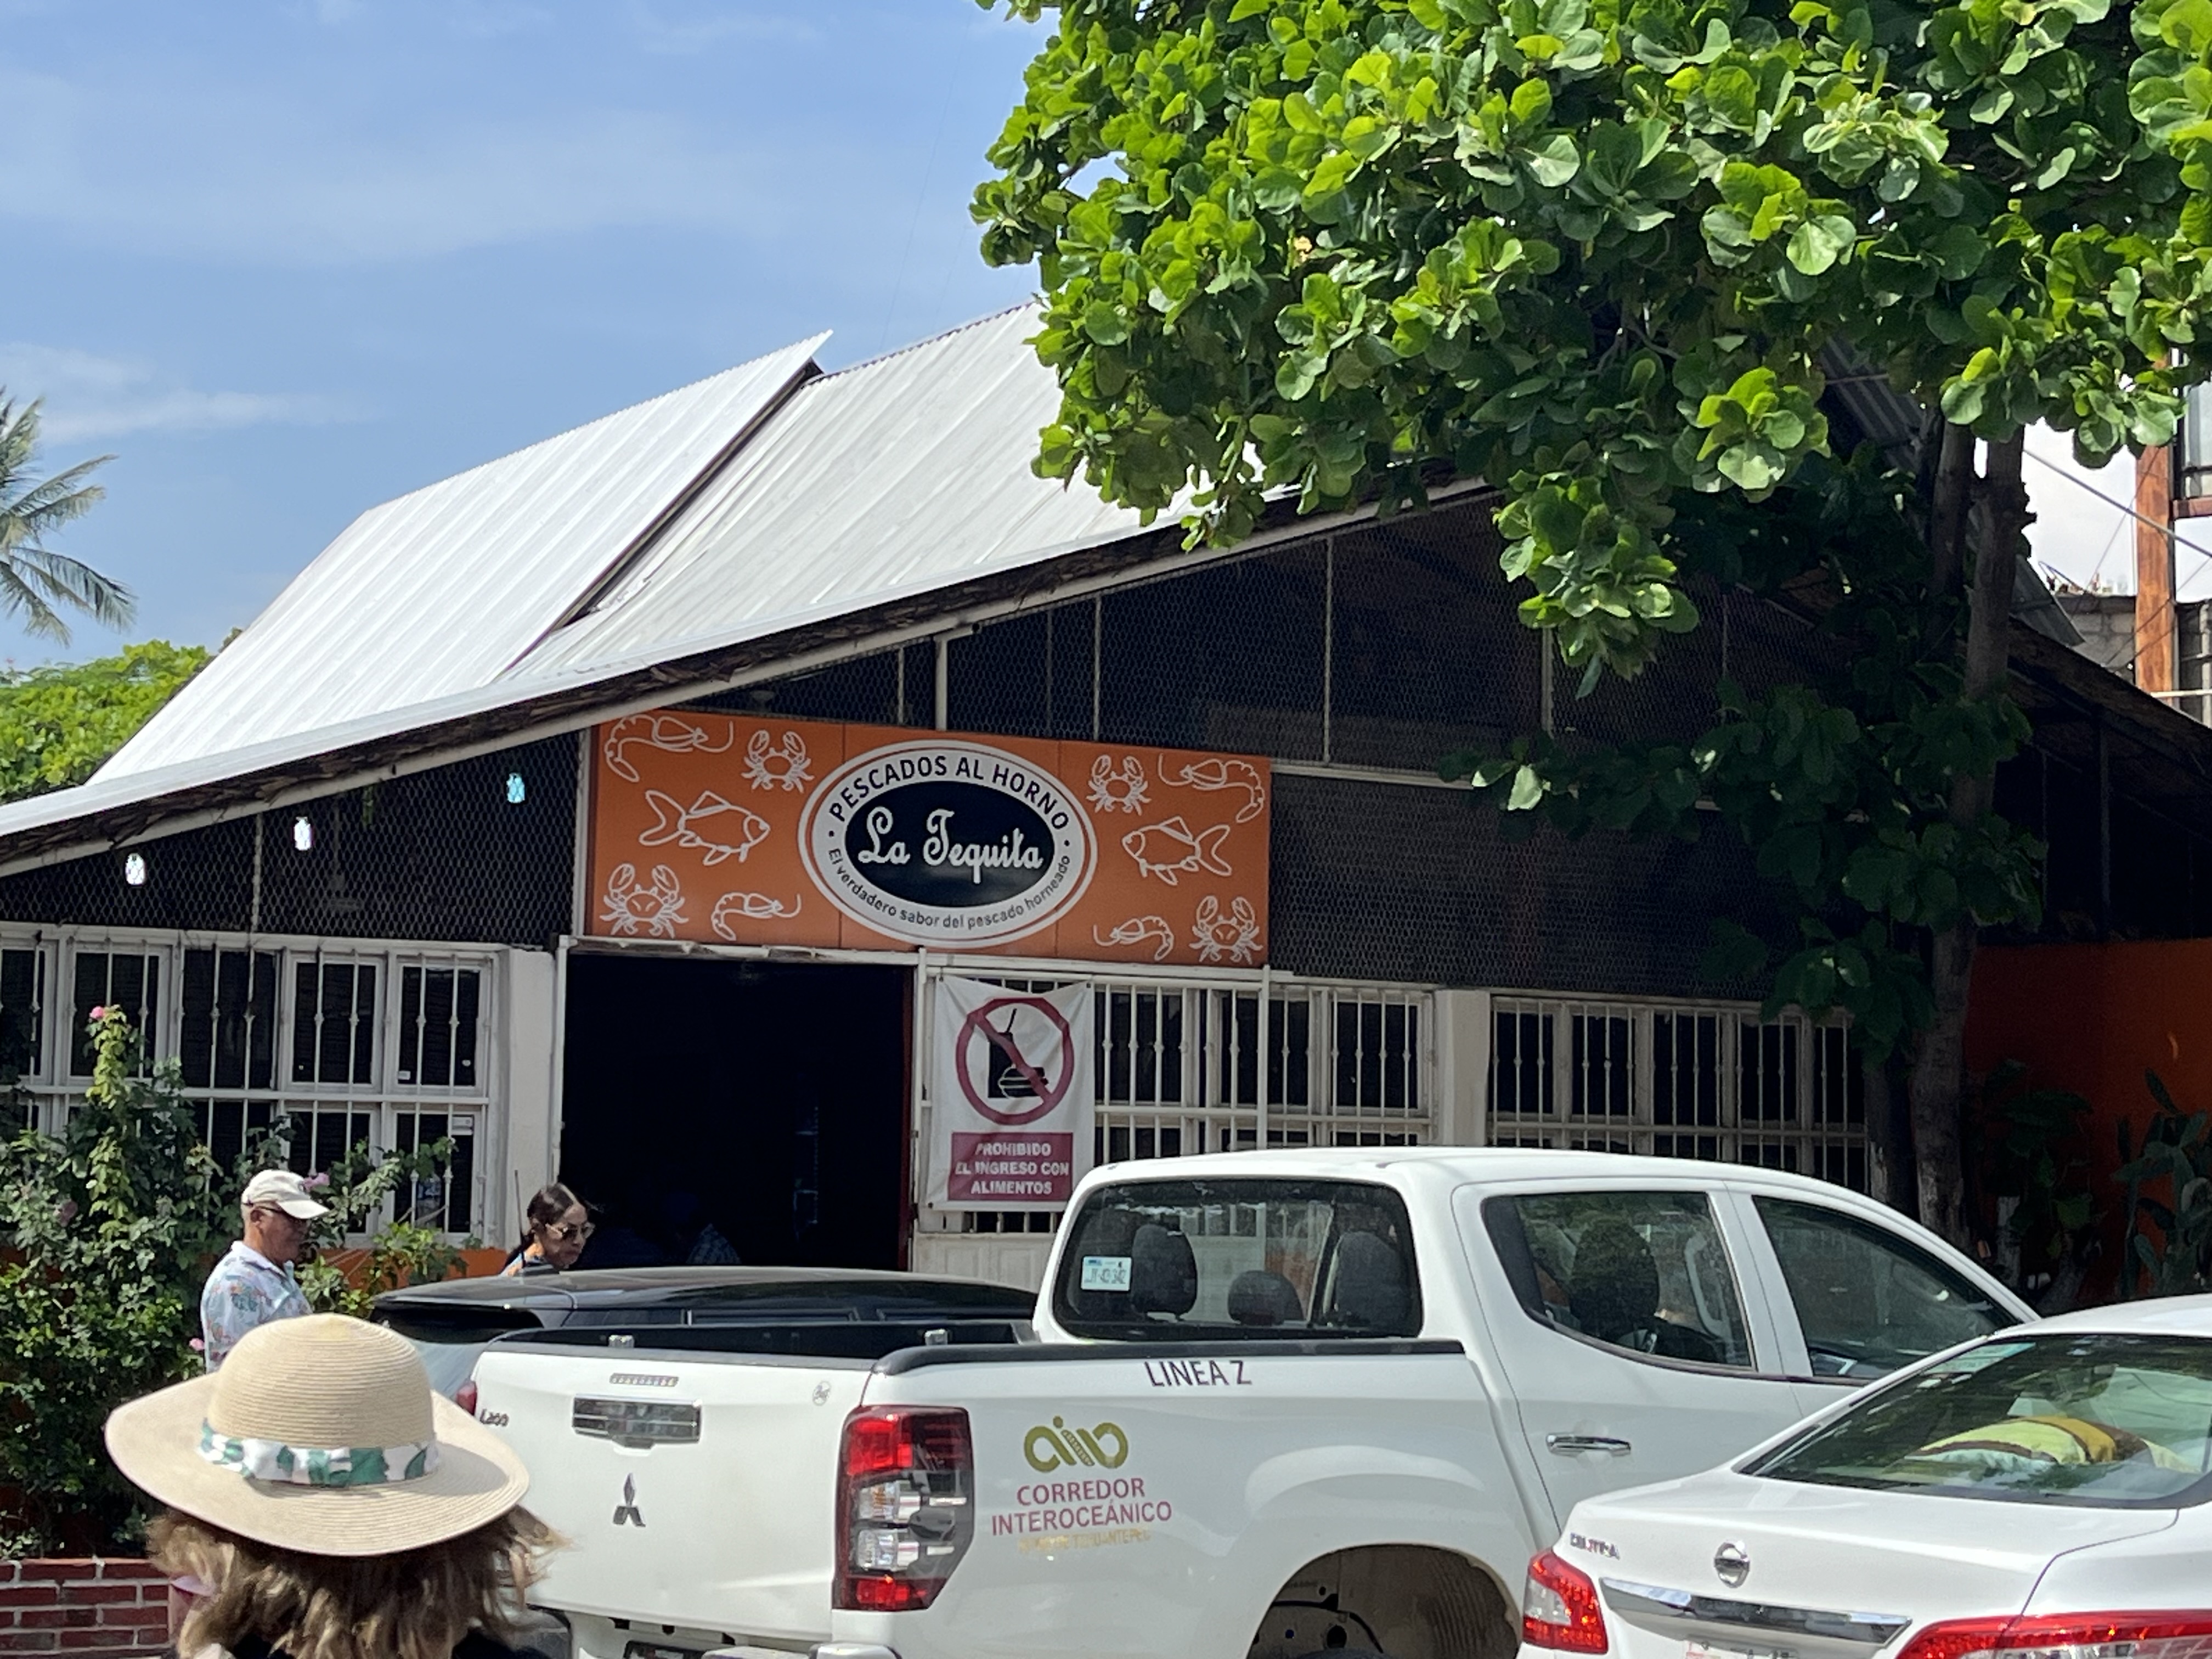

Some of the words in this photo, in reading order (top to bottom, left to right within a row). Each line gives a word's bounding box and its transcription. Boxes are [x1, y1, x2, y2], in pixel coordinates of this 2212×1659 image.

[829, 755, 947, 822] PESCADOS
[956, 757, 984, 780] AL
[992, 763, 1069, 830] HORNO
[857, 806, 911, 865] La
[828, 848, 843, 865] El
[837, 866, 896, 916] verdadero
[900, 910, 939, 928] sabor
[943, 914, 964, 928] del
[968, 904, 1024, 930] pescado
[1024, 855, 1070, 911] horneado
[955, 1161, 972, 1175] EL
[974, 1161, 1038, 1175] INGRESO
[1040, 1162, 1069, 1176] CON
[970, 1180, 1052, 1195] ALIMENTOS
[1144, 1359, 1229, 1387] LINEA
[1229, 1359, 1252, 1385] Z
[1017, 1478, 1146, 1506] CORREDOR
[992, 1499, 1172, 1536] INTEROCEÁNICO
